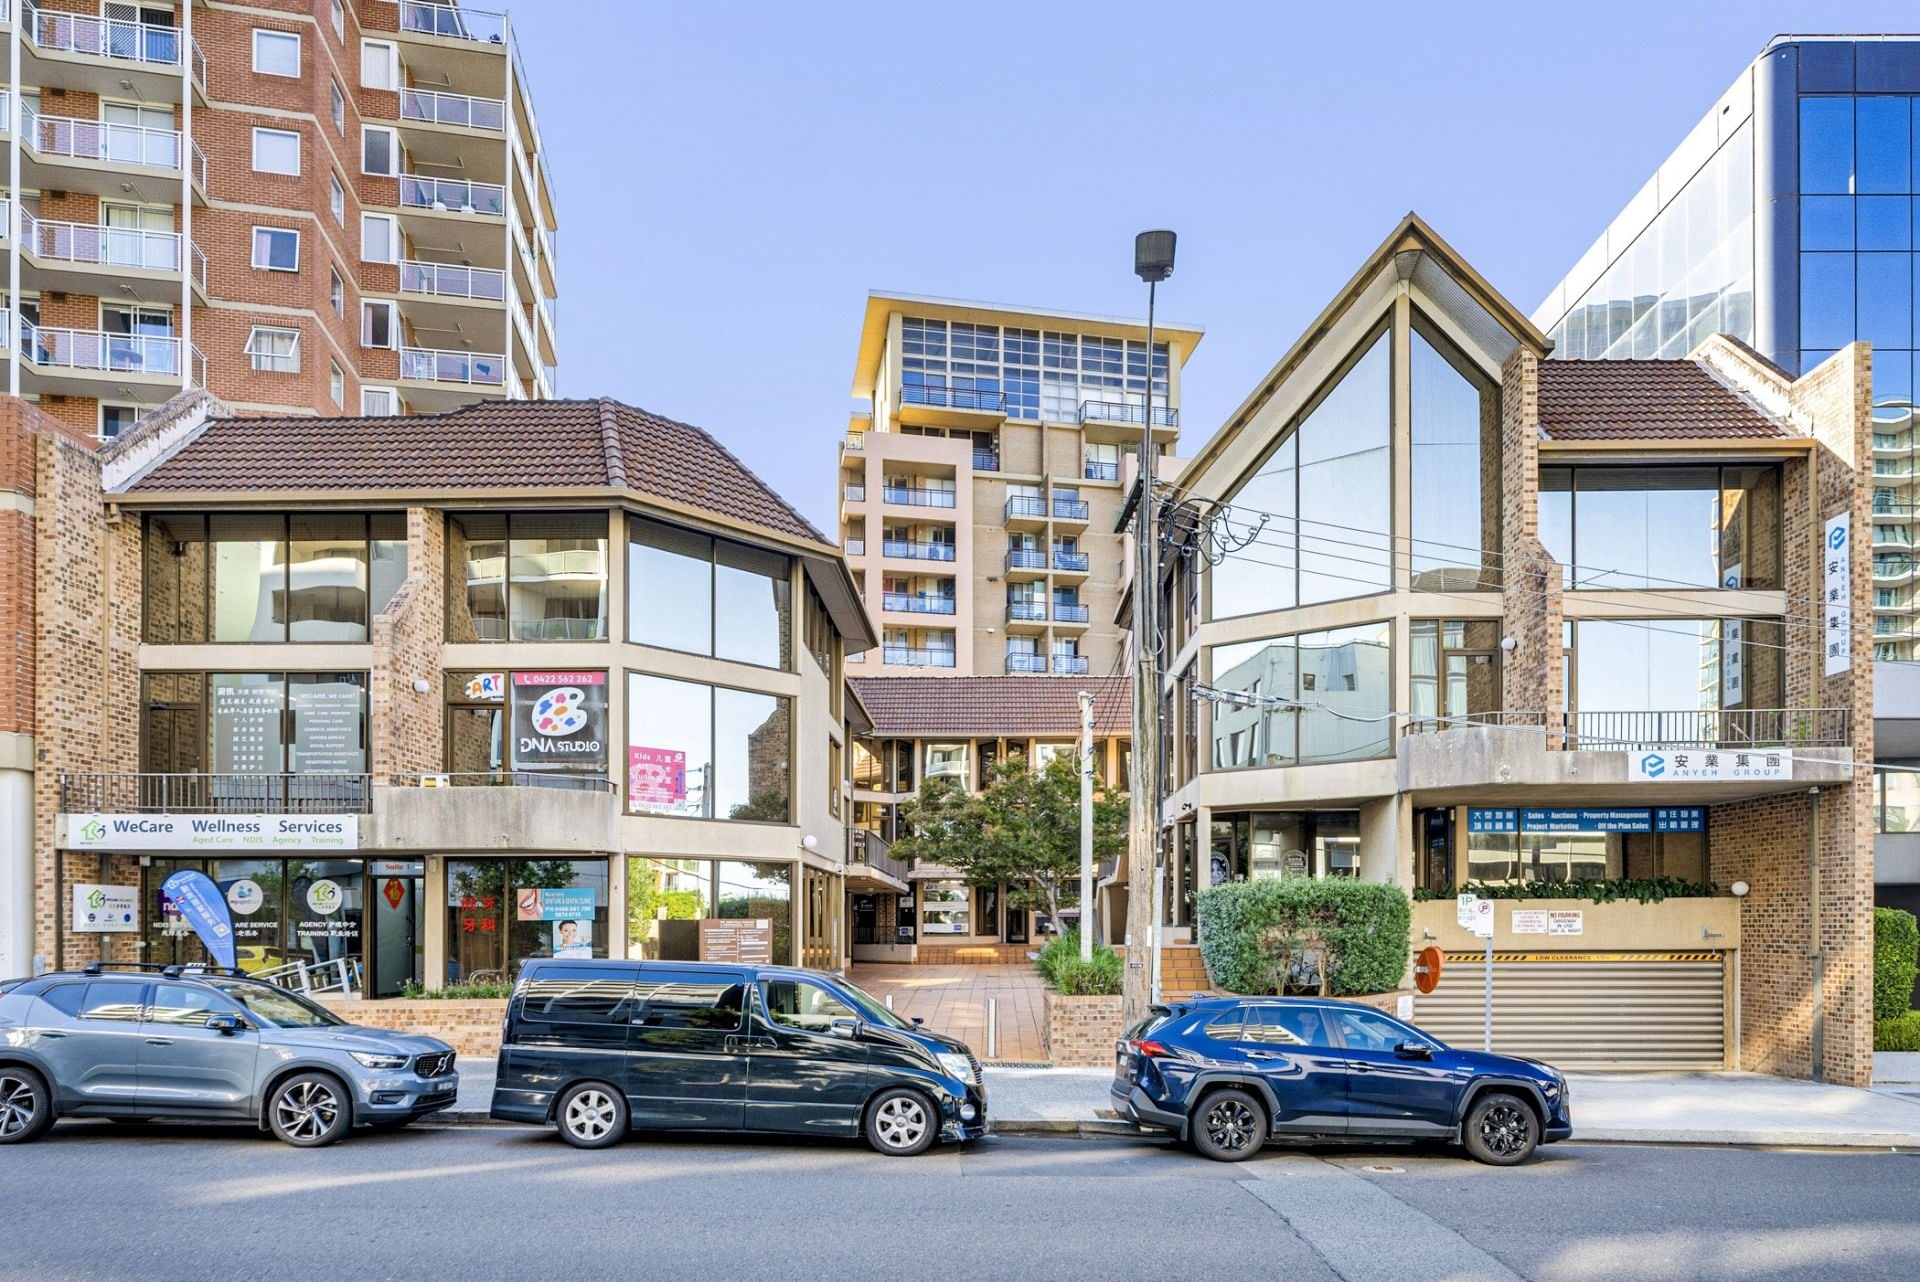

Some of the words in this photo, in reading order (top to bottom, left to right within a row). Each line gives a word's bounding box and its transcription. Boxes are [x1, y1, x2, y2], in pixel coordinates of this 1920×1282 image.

[1828, 559, 1840, 658] 安業集團
[472, 675, 501, 694] ART
[533, 675, 558, 683] 0422
[558, 675, 575, 683] 562
[576, 675, 593, 683] 262
[520, 738, 555, 753] DNA
[557, 741, 600, 752] STUDIO
[634, 752, 651, 760] Kids
[1674, 753, 1781, 768] 安業集團
[1583, 812, 1609, 820] Property
[113, 820, 174, 833] WeCare
[192, 820, 260, 833] Wellness
[279, 820, 343, 833] Services
[1527, 823, 1548, 831] Project
[1549, 823, 1579, 831] Marketing
[192, 836, 214, 845] Aged
[216, 836, 234, 844] Care
[243, 836, 263, 844] NDIS
[272, 836, 302, 845] Agency
[311, 836, 344, 845] Training
[1461, 896, 1473, 906] 1P
[463, 916, 496, 933] 牙科
